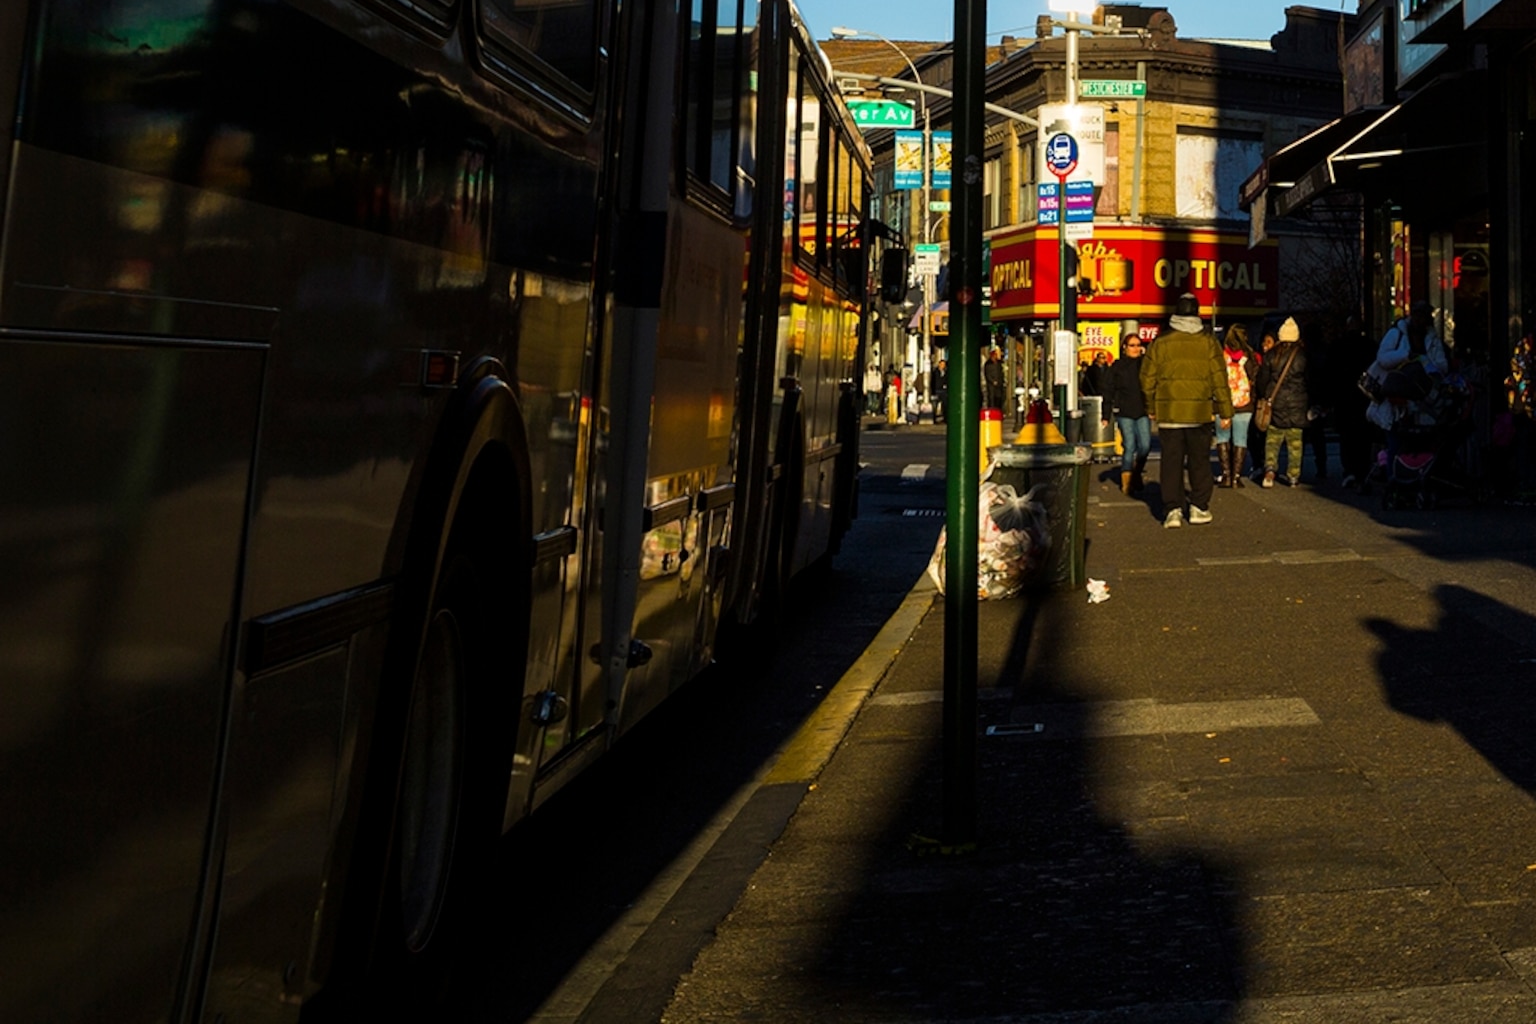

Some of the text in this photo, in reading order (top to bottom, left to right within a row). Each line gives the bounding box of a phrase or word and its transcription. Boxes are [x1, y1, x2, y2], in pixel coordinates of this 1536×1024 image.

[1075, 131, 1101, 140] OUTE
[992, 259, 1033, 293] OPTICAL
[1154, 259, 1267, 291] OPTICAL
[1085, 326, 1103, 336] EYE
[1139, 327, 1158, 340] EYE
[1085, 336, 1114, 346] ASSES
